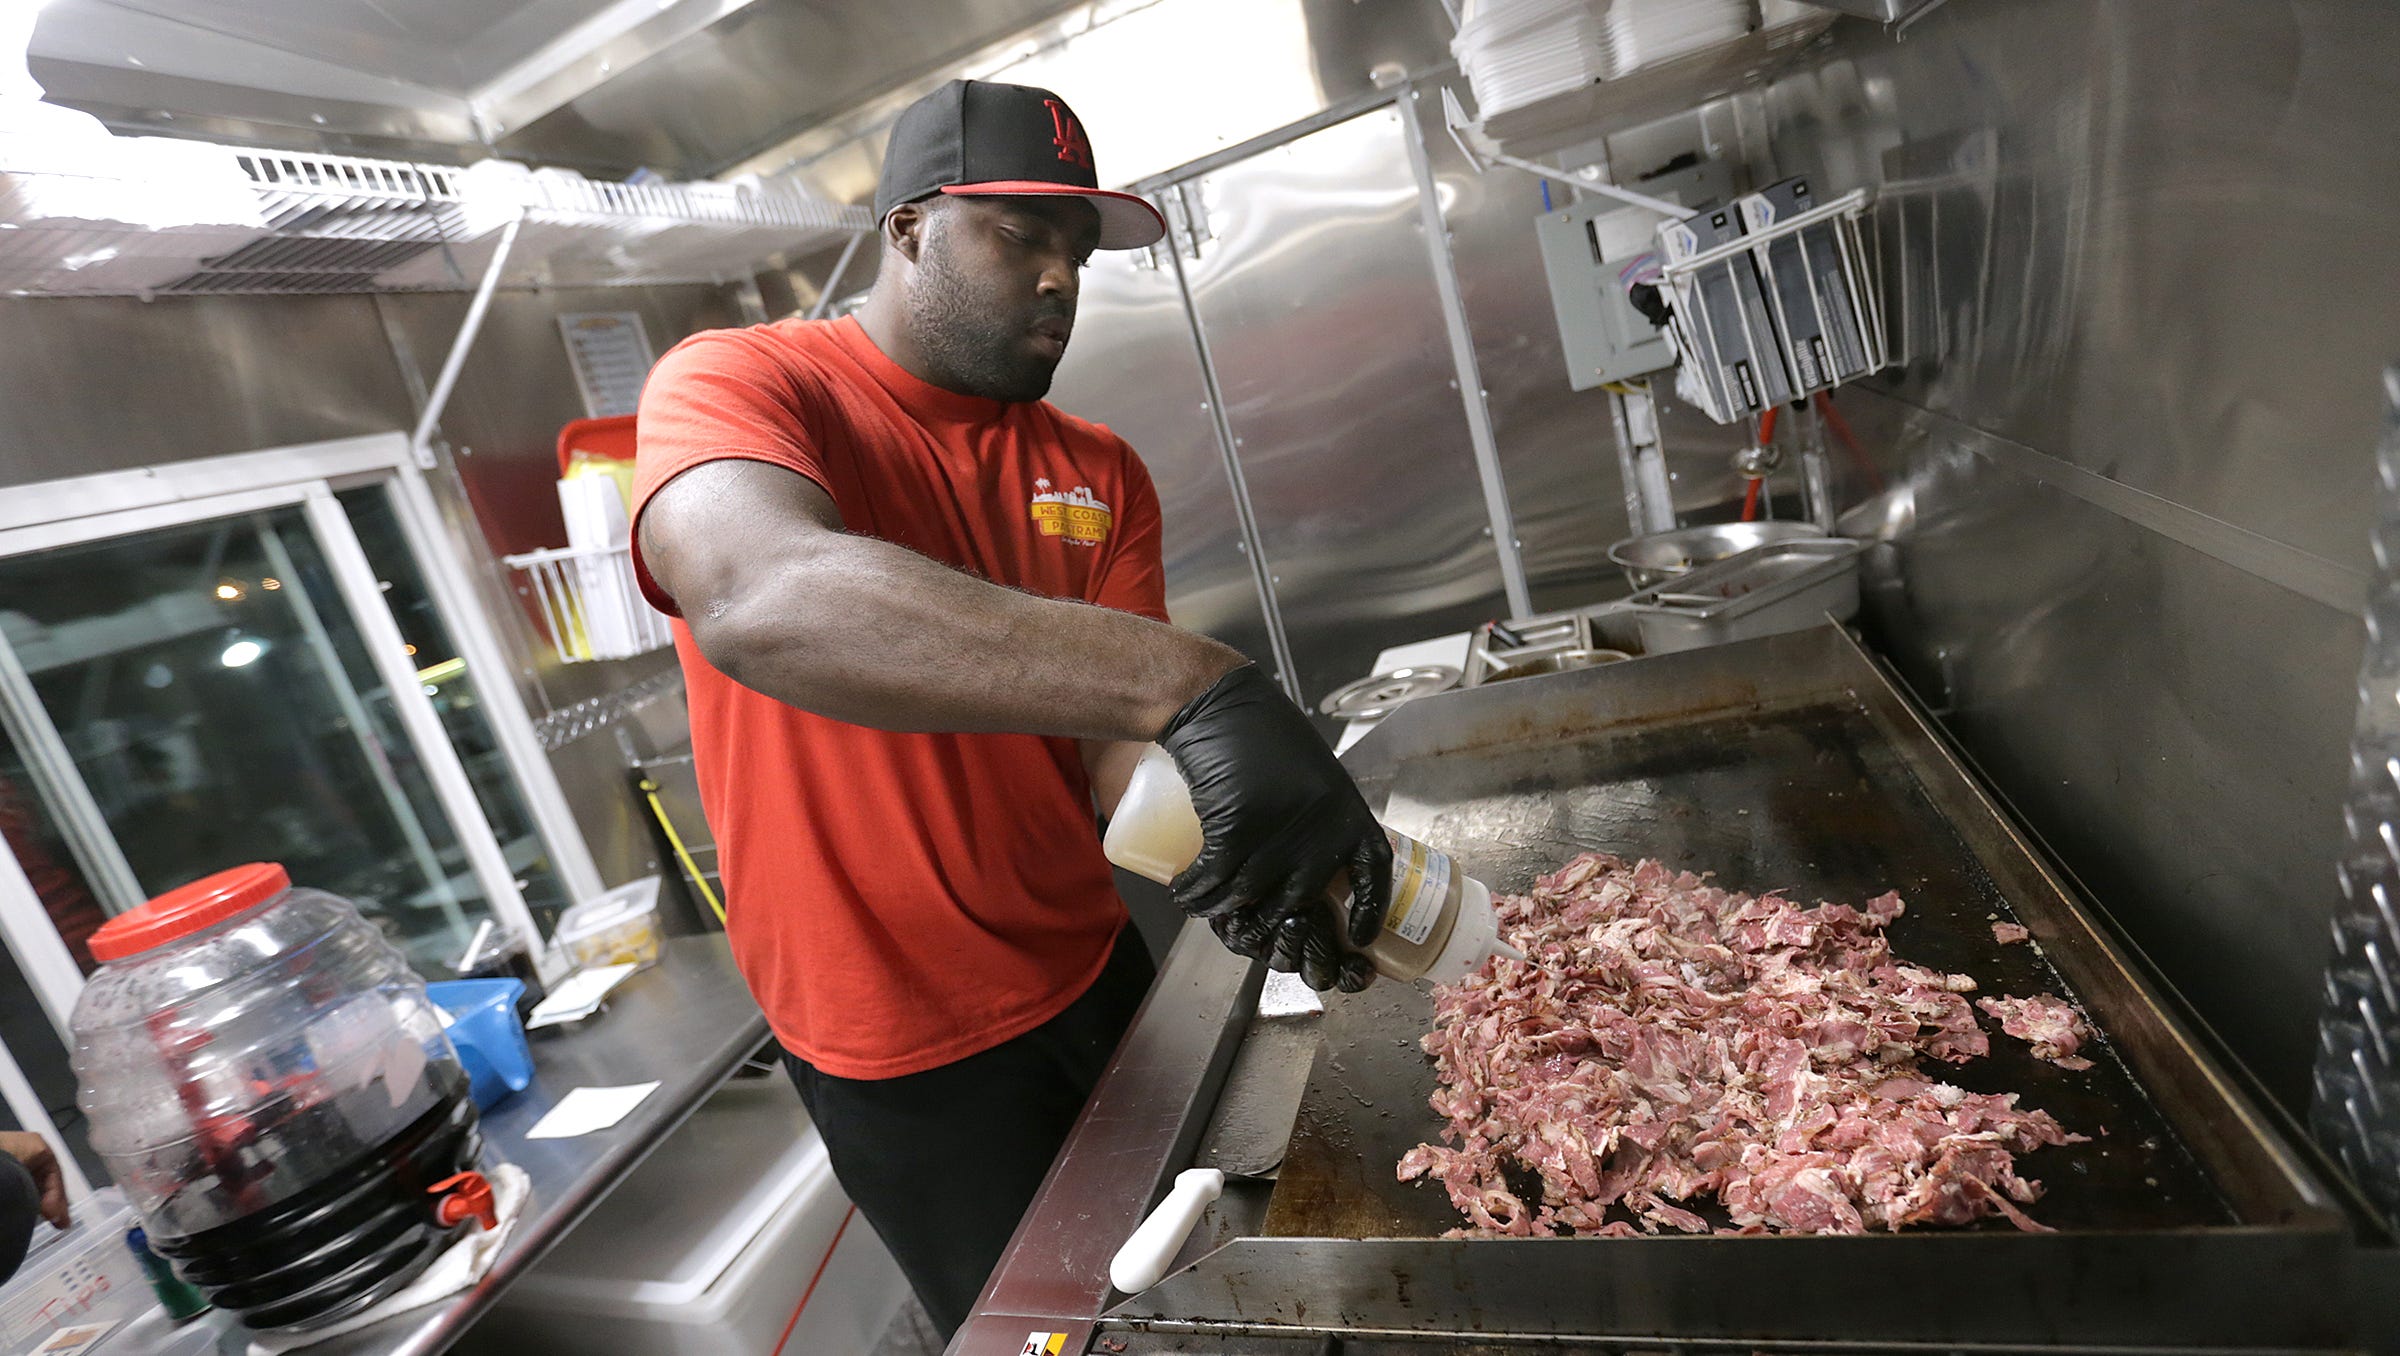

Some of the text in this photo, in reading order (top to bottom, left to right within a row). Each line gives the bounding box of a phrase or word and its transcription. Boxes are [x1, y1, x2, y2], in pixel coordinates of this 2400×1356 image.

[1043, 99, 1091, 169] LA
[1040, 505, 1109, 524] WEST COAST
